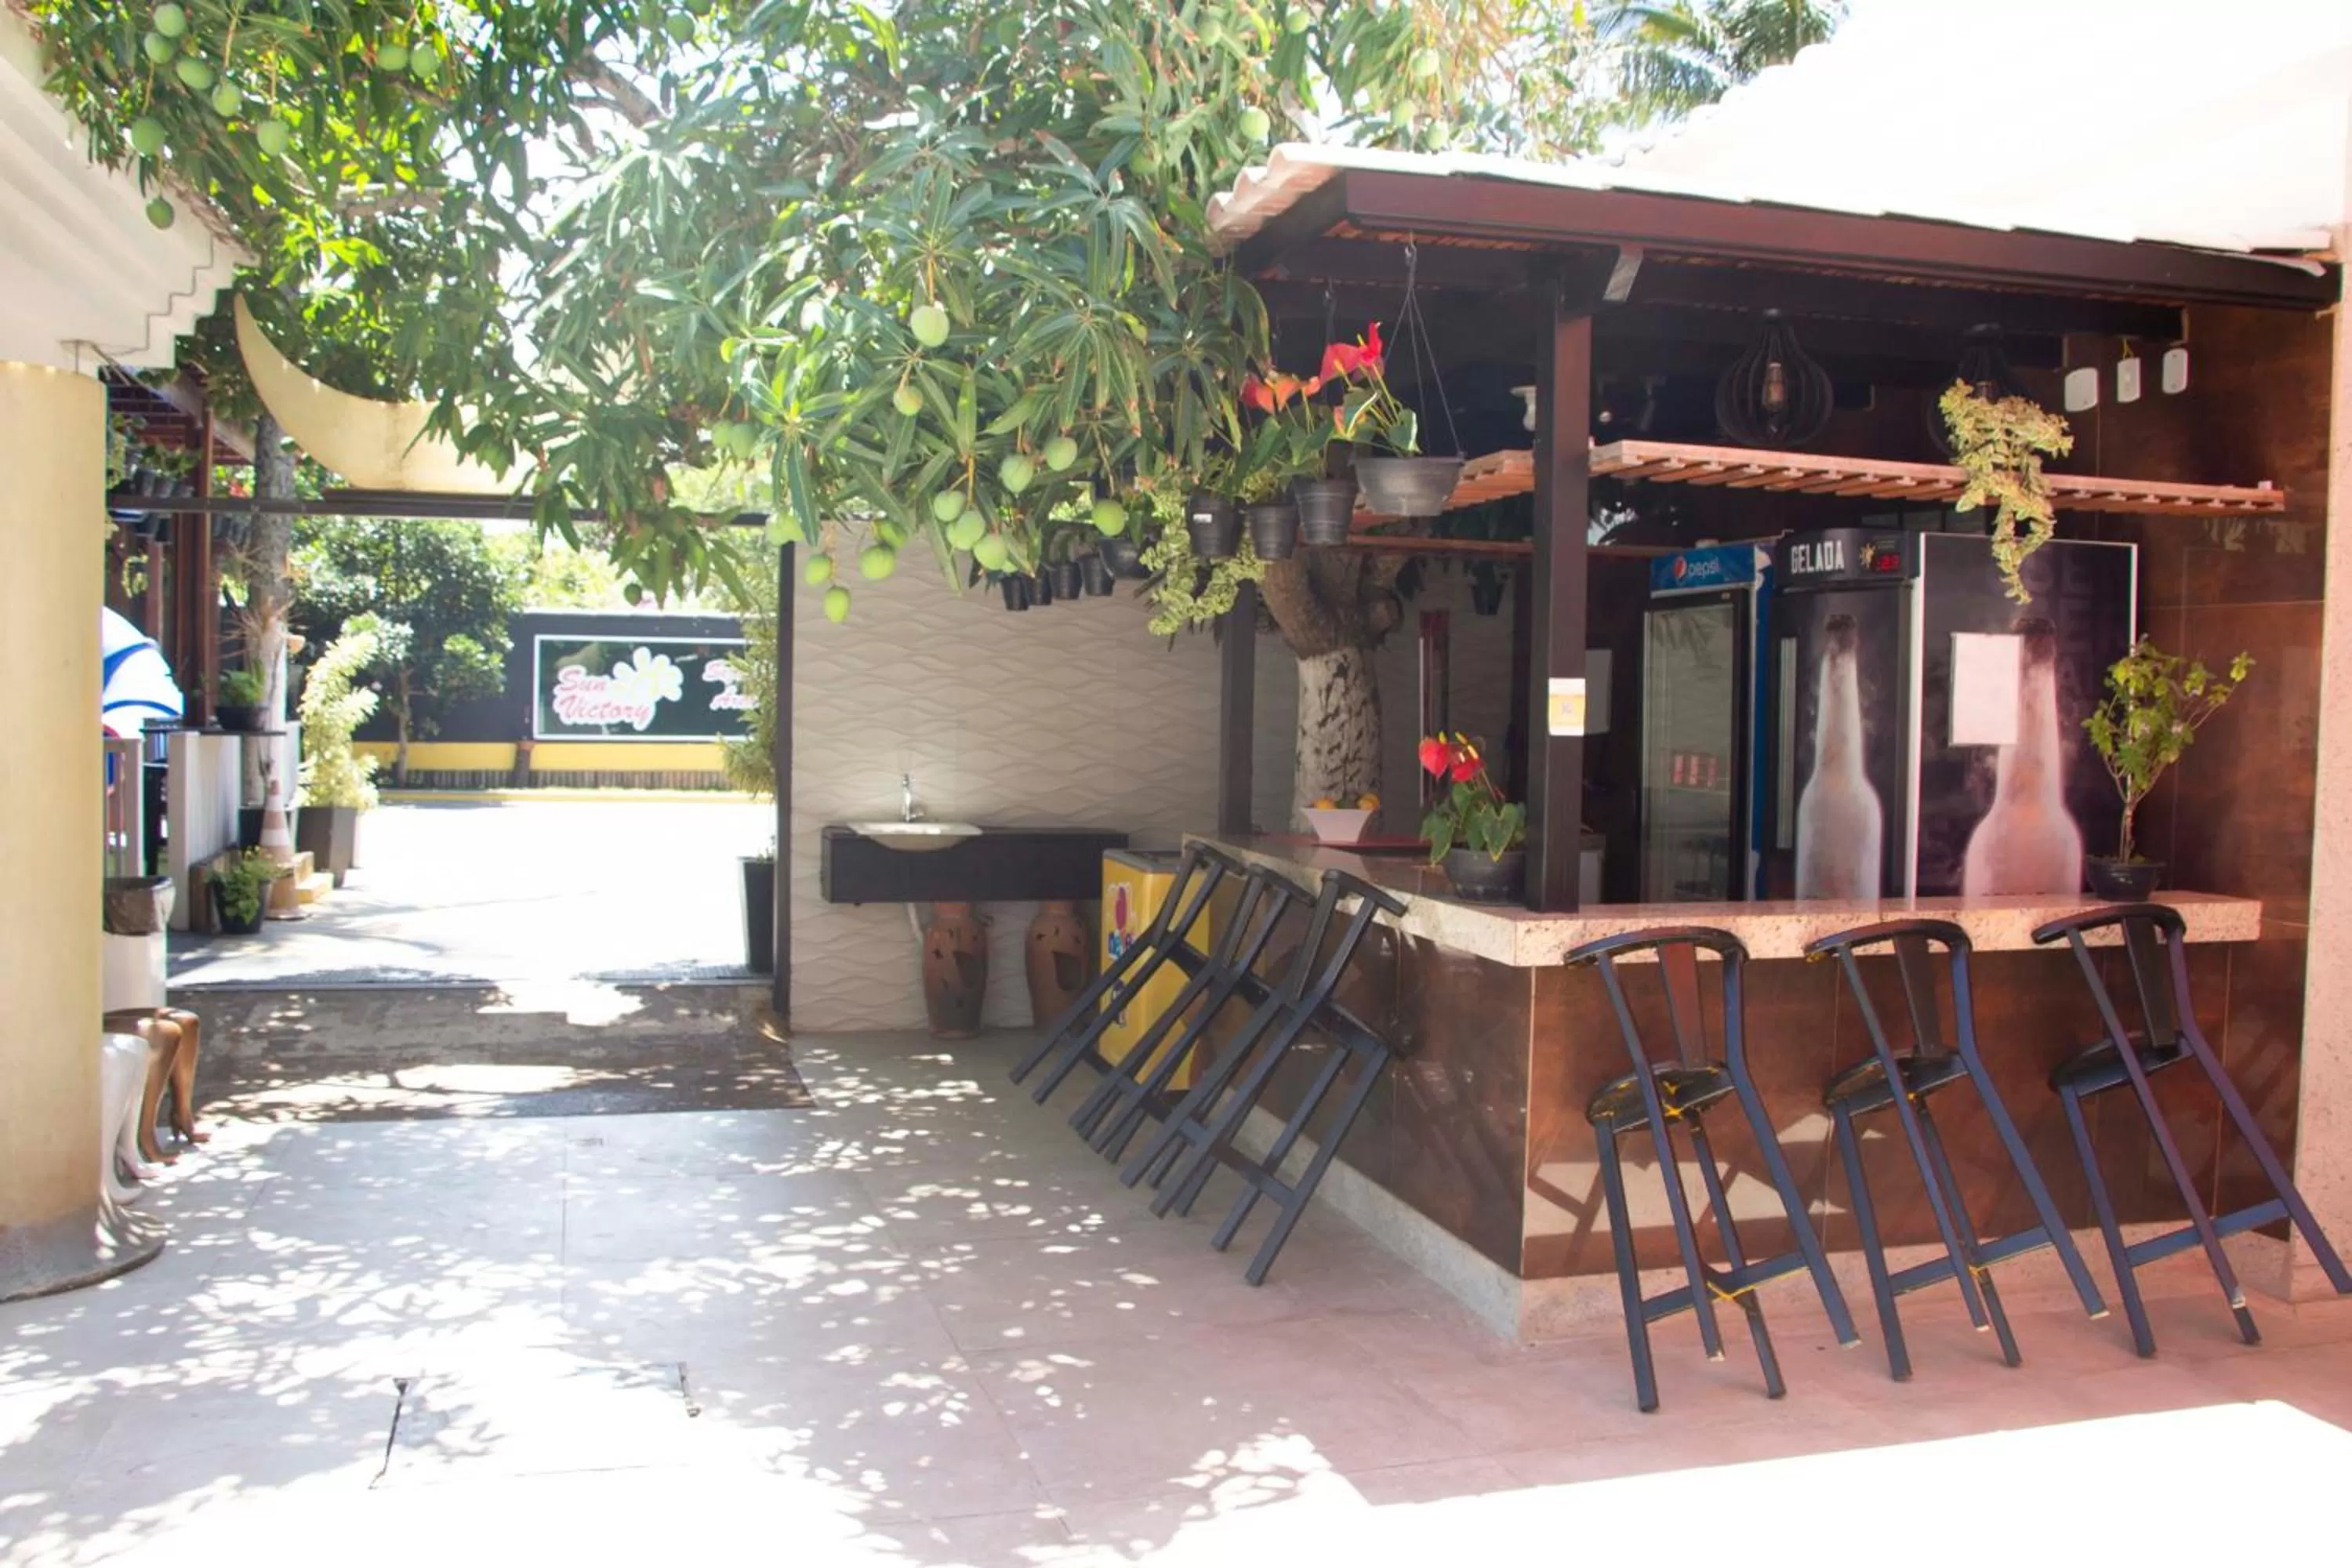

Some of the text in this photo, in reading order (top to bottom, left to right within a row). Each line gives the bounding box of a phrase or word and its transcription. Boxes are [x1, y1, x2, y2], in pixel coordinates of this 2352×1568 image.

[1687, 555, 1721, 578] pepsi
[1791, 539, 1845, 575] GELADA
[559, 669, 606, 691] Sun
[559, 695, 650, 725] Victory
